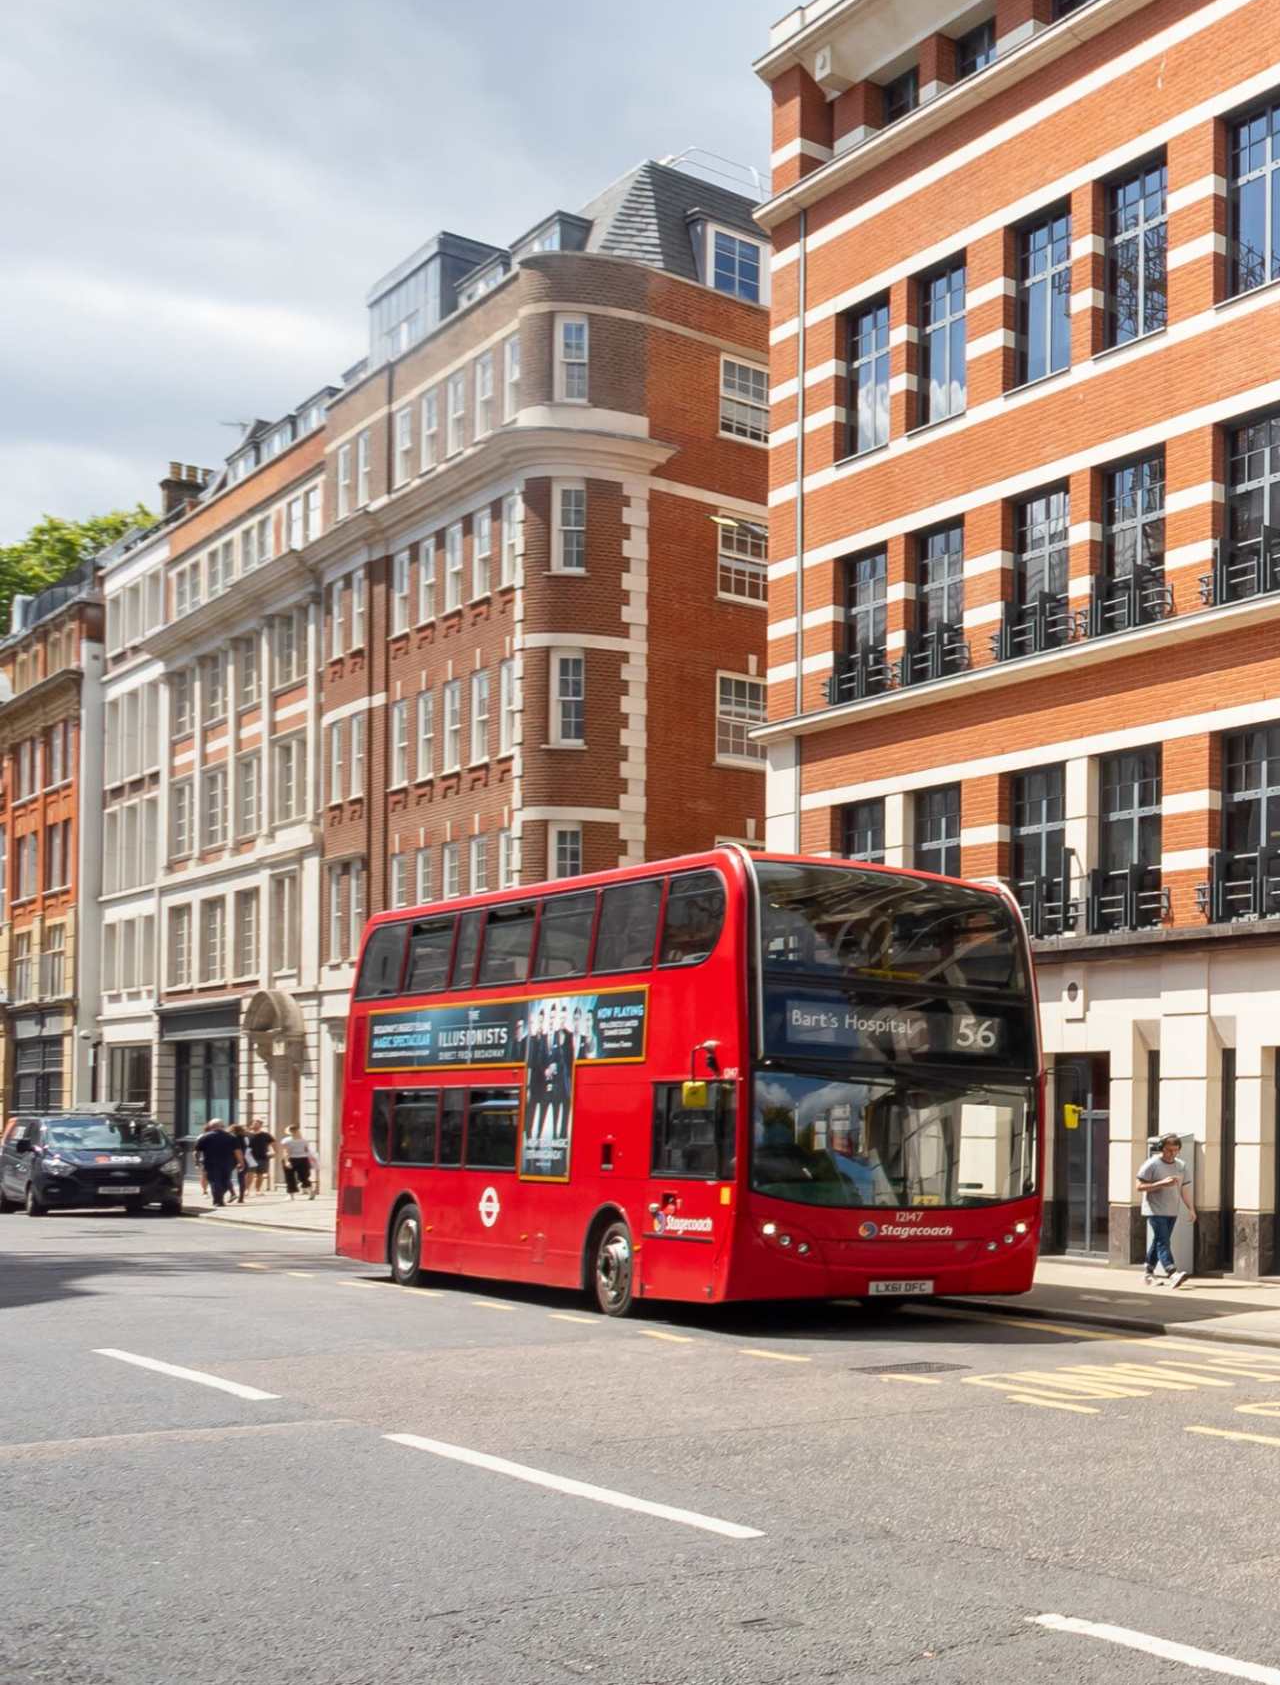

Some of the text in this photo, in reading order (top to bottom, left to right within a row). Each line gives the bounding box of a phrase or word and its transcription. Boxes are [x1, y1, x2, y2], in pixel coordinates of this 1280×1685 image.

[791, 1009, 912, 1035] Bart's Hospital
[956, 1018, 996, 1048] 56
[438, 1027, 508, 1048] ILLUSIONISTS
[880, 1224, 953, 1238] Stagecoach
